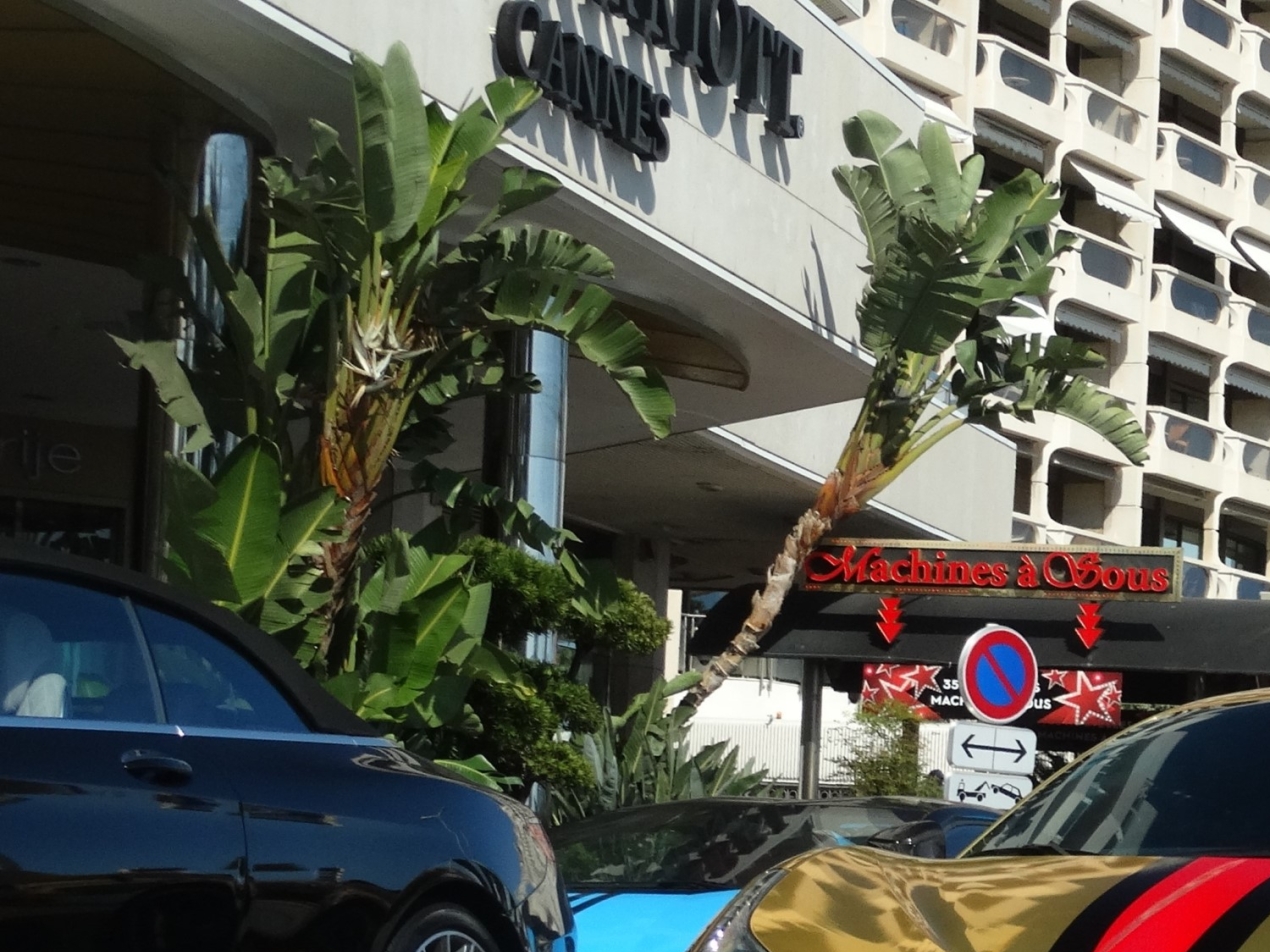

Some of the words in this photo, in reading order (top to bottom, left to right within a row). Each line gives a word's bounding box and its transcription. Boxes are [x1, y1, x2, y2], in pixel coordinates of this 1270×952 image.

[496, 1, 671, 162] CANNES
[804, 545, 1009, 587] Machines
[1017, 554, 1040, 588] à
[1042, 551, 1169, 592] Sous
